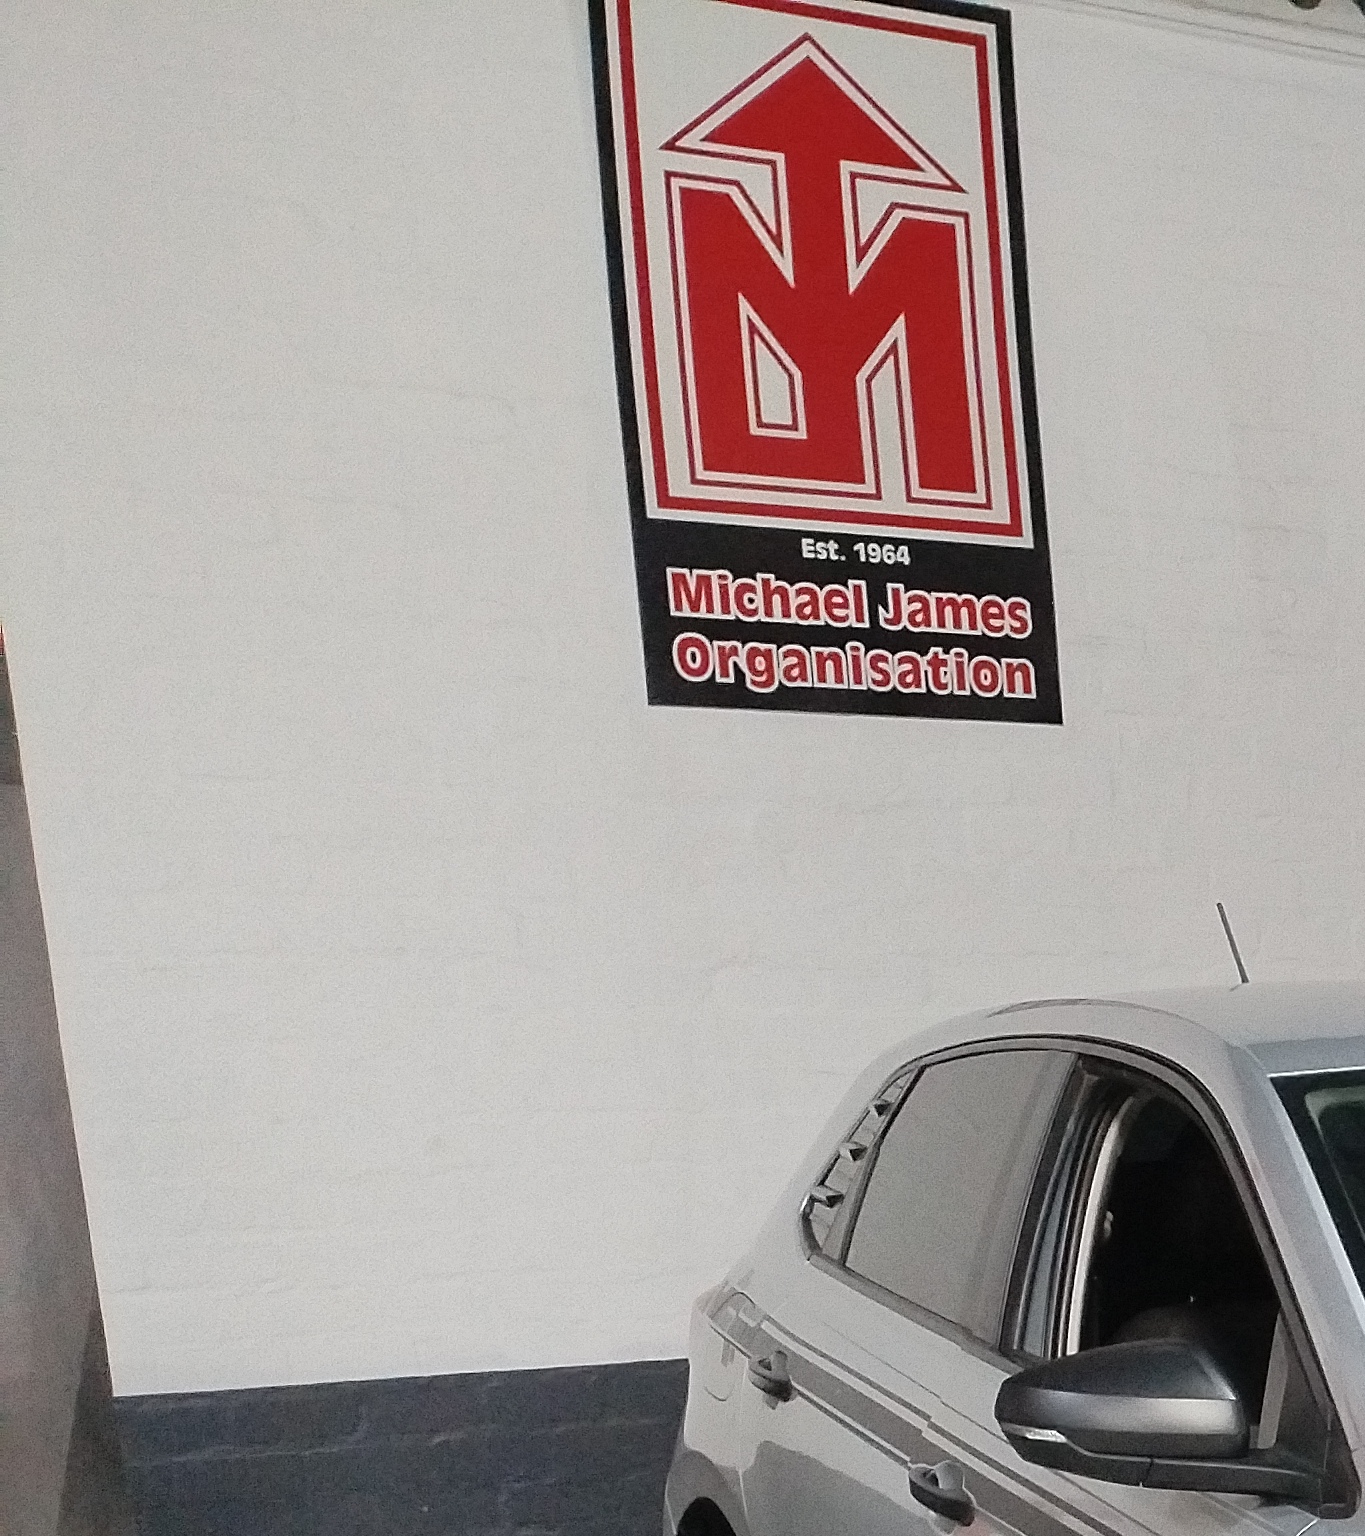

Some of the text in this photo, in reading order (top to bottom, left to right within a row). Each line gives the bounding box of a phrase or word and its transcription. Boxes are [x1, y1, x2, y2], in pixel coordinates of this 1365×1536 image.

[801, 538, 911, 565] Est. 1964
[666, 567, 1032, 638] Michael James
[673, 632, 1036, 700] Organisation
